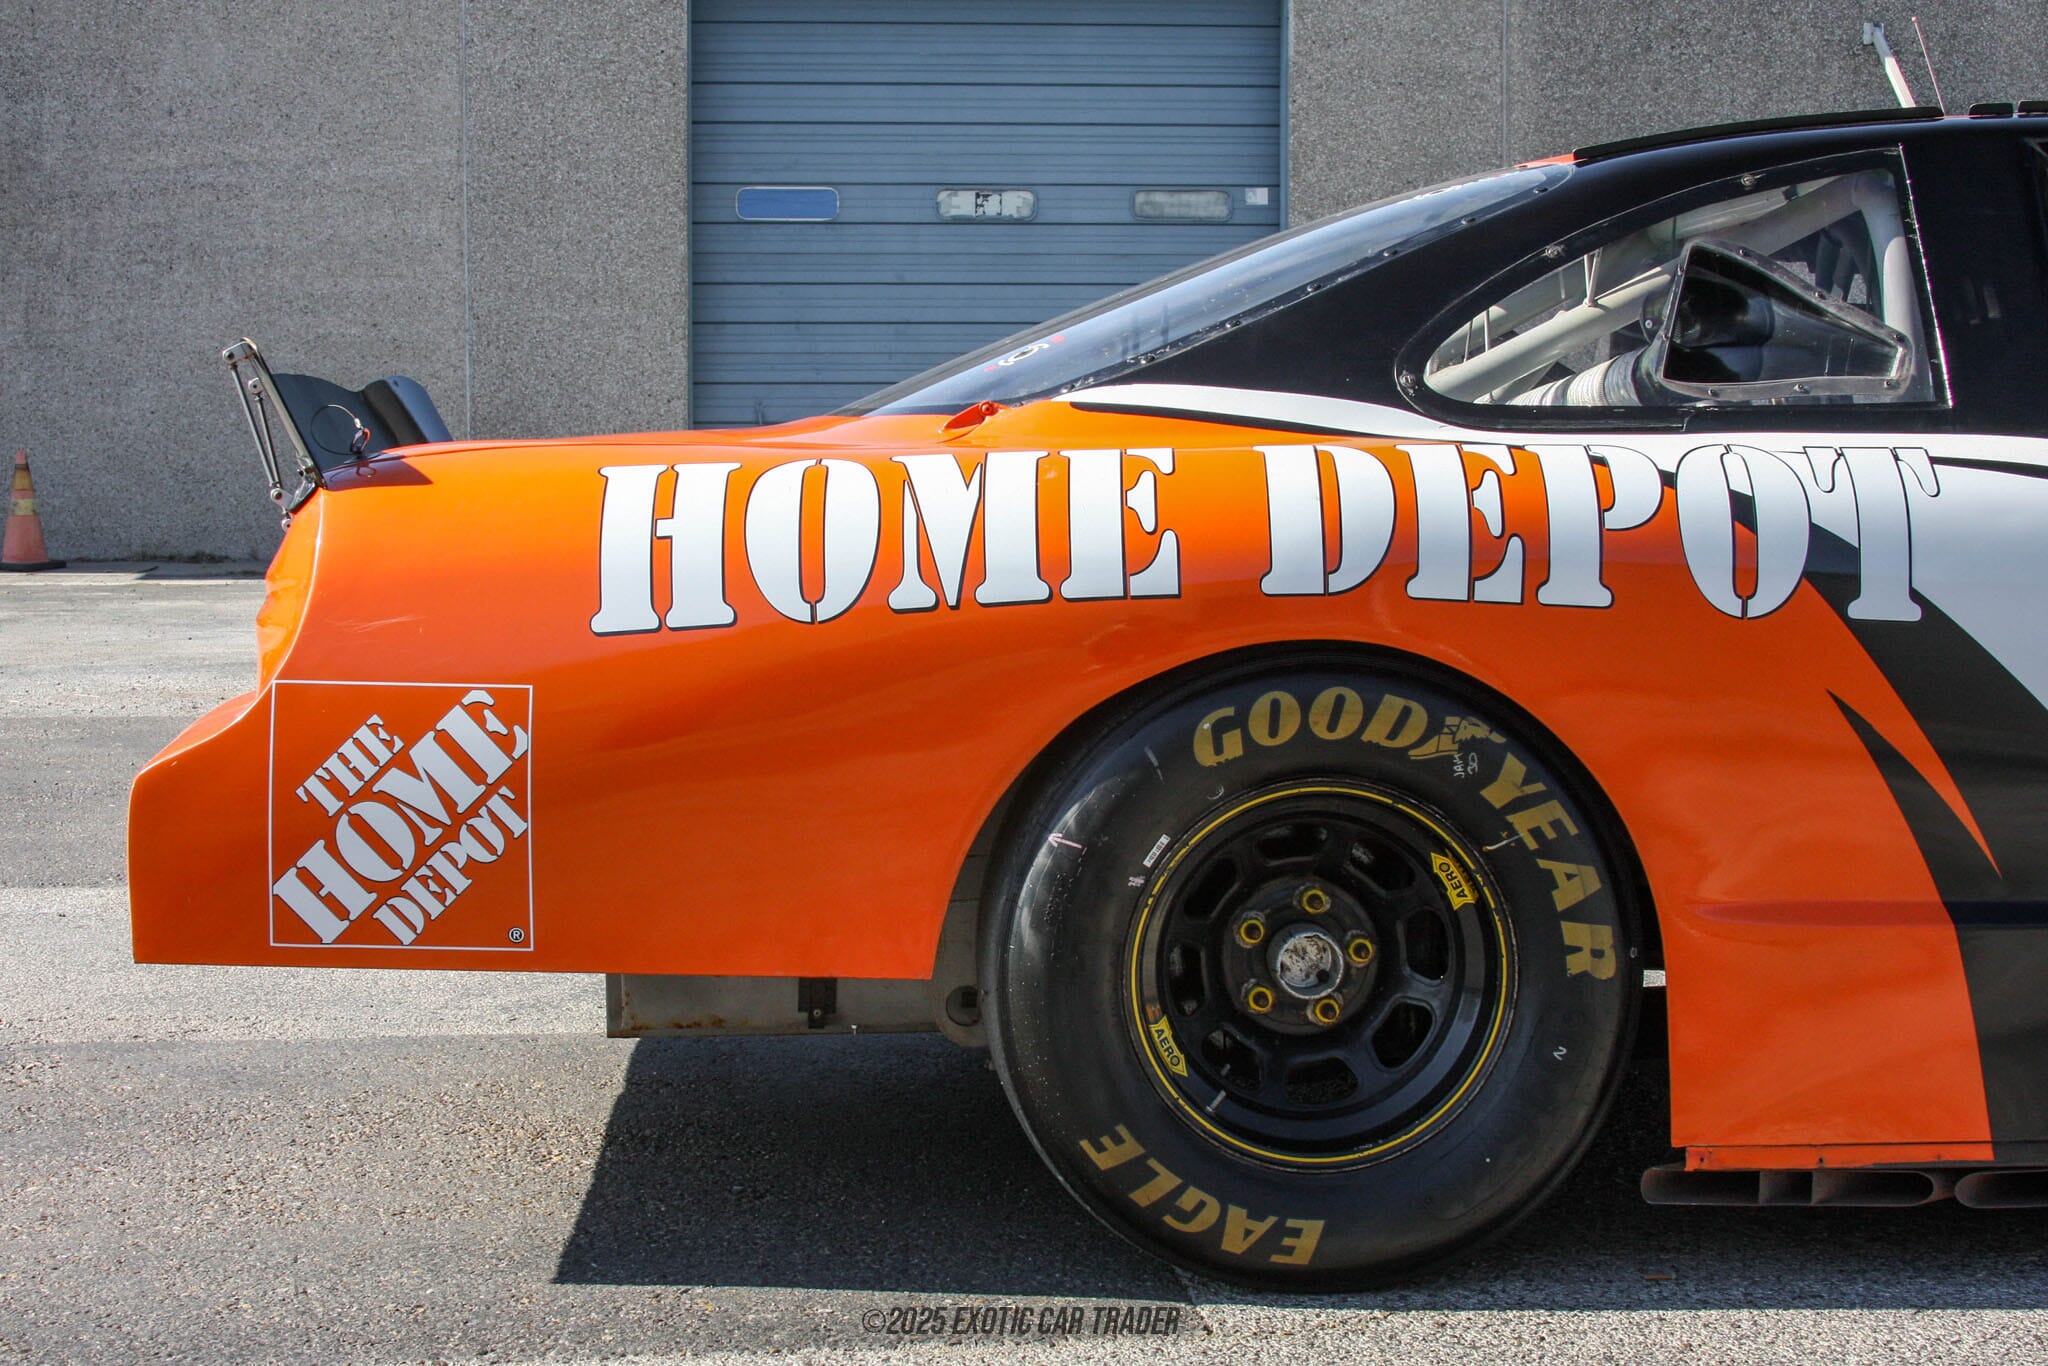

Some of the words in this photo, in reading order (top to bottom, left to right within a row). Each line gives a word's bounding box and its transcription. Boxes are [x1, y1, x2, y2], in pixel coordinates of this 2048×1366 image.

[589, 447, 1181, 637] HOME
[1253, 443, 1940, 622] DEPOT
[272, 689, 529, 945] HOME
[295, 713, 405, 818] THE
[372, 785, 528, 946] DEPOT
[1438, 862, 1469, 898] AERO
[1154, 1028, 1181, 1067] AERO
[1080, 1124, 1325, 1265] EAGLE
